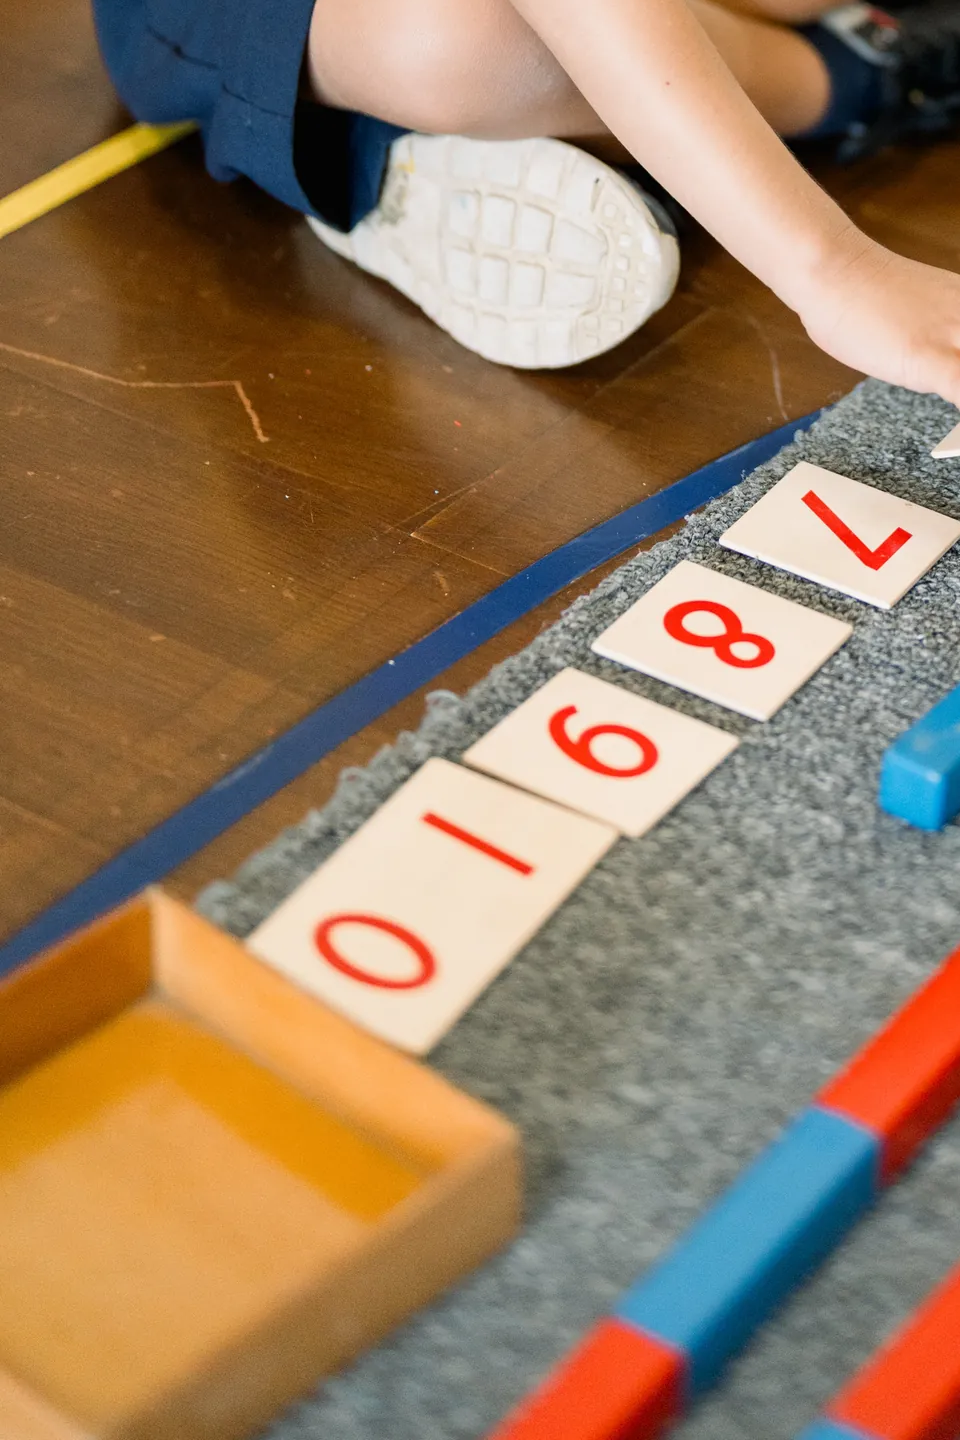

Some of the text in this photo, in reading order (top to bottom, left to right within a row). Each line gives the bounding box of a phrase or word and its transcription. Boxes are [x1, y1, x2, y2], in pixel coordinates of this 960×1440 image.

[801, 489, 913, 572] 7
[662, 599, 776, 670] 8
[547, 704, 659, 780] 9
